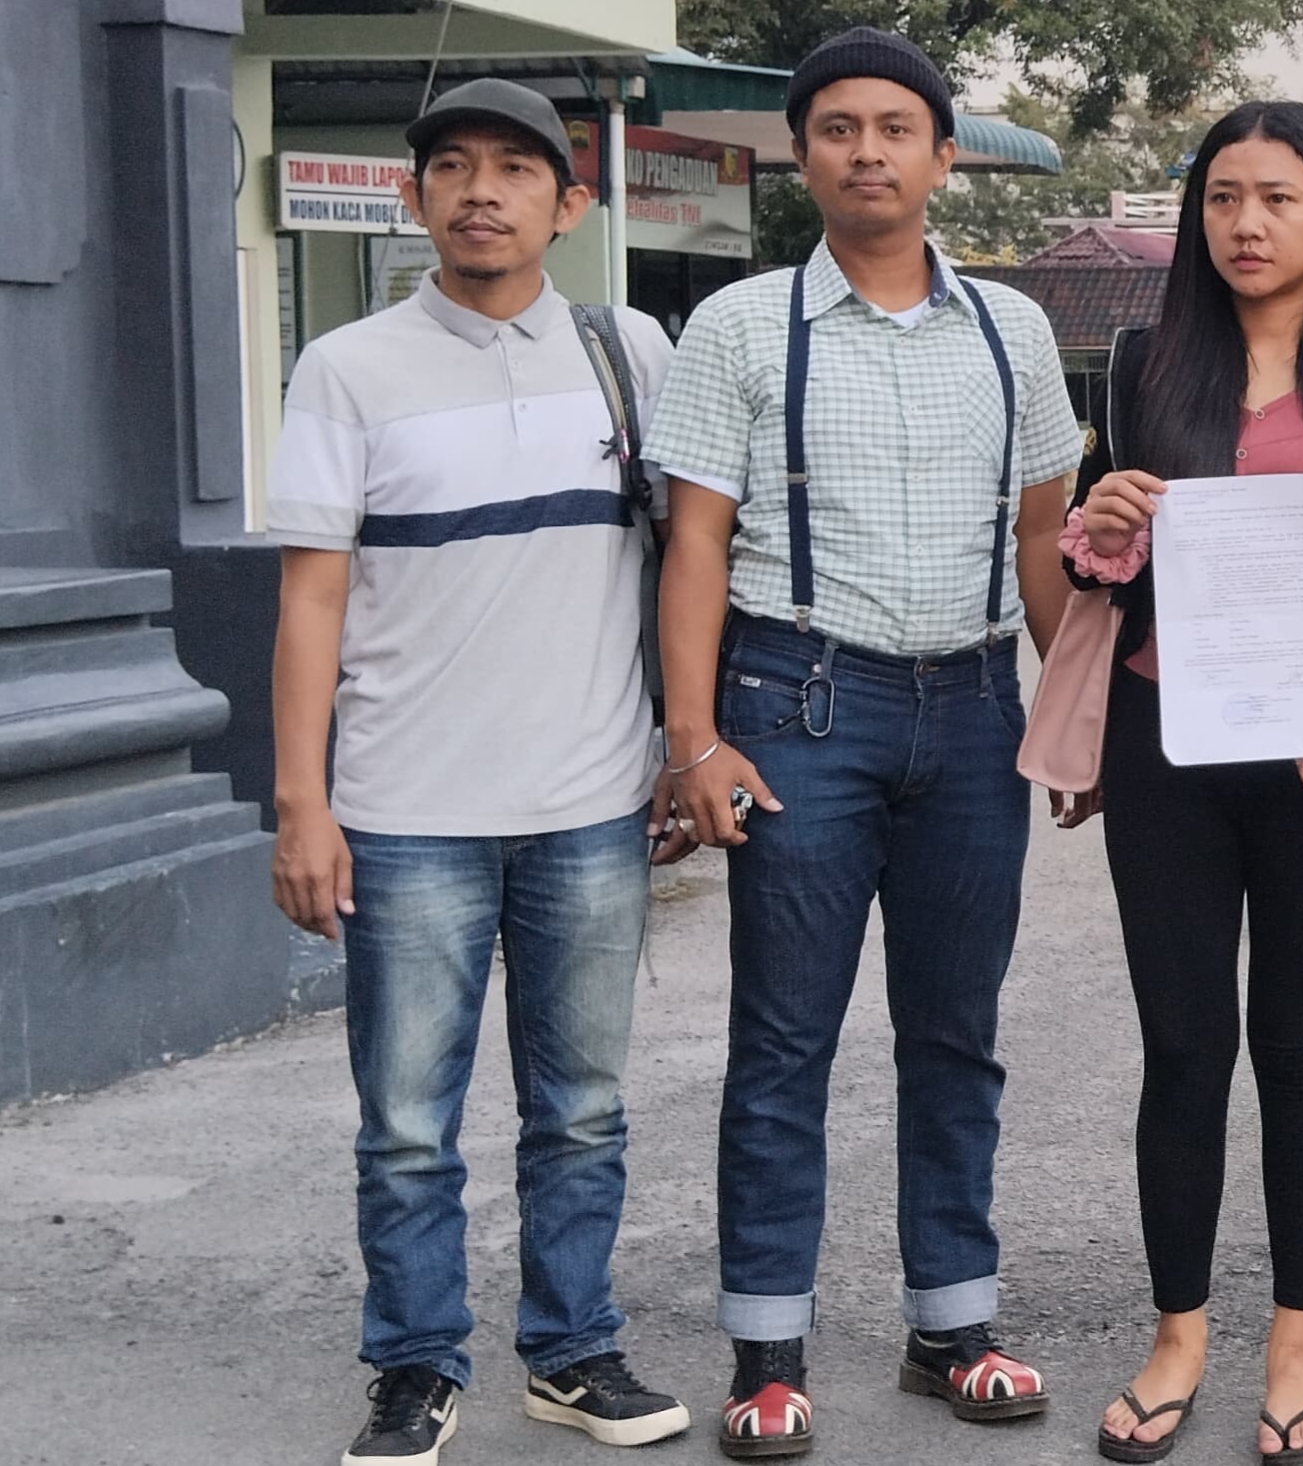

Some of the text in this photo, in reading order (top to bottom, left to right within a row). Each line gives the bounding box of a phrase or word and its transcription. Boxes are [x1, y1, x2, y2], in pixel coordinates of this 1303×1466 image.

[287, 160, 407, 188] TAMU WAJIB LAPO
[645, 152, 718, 196] PENGADUAN
[289, 199, 331, 220] MOHON
[333, 202, 362, 223] KACA
[627, 198, 678, 224] etralitas
